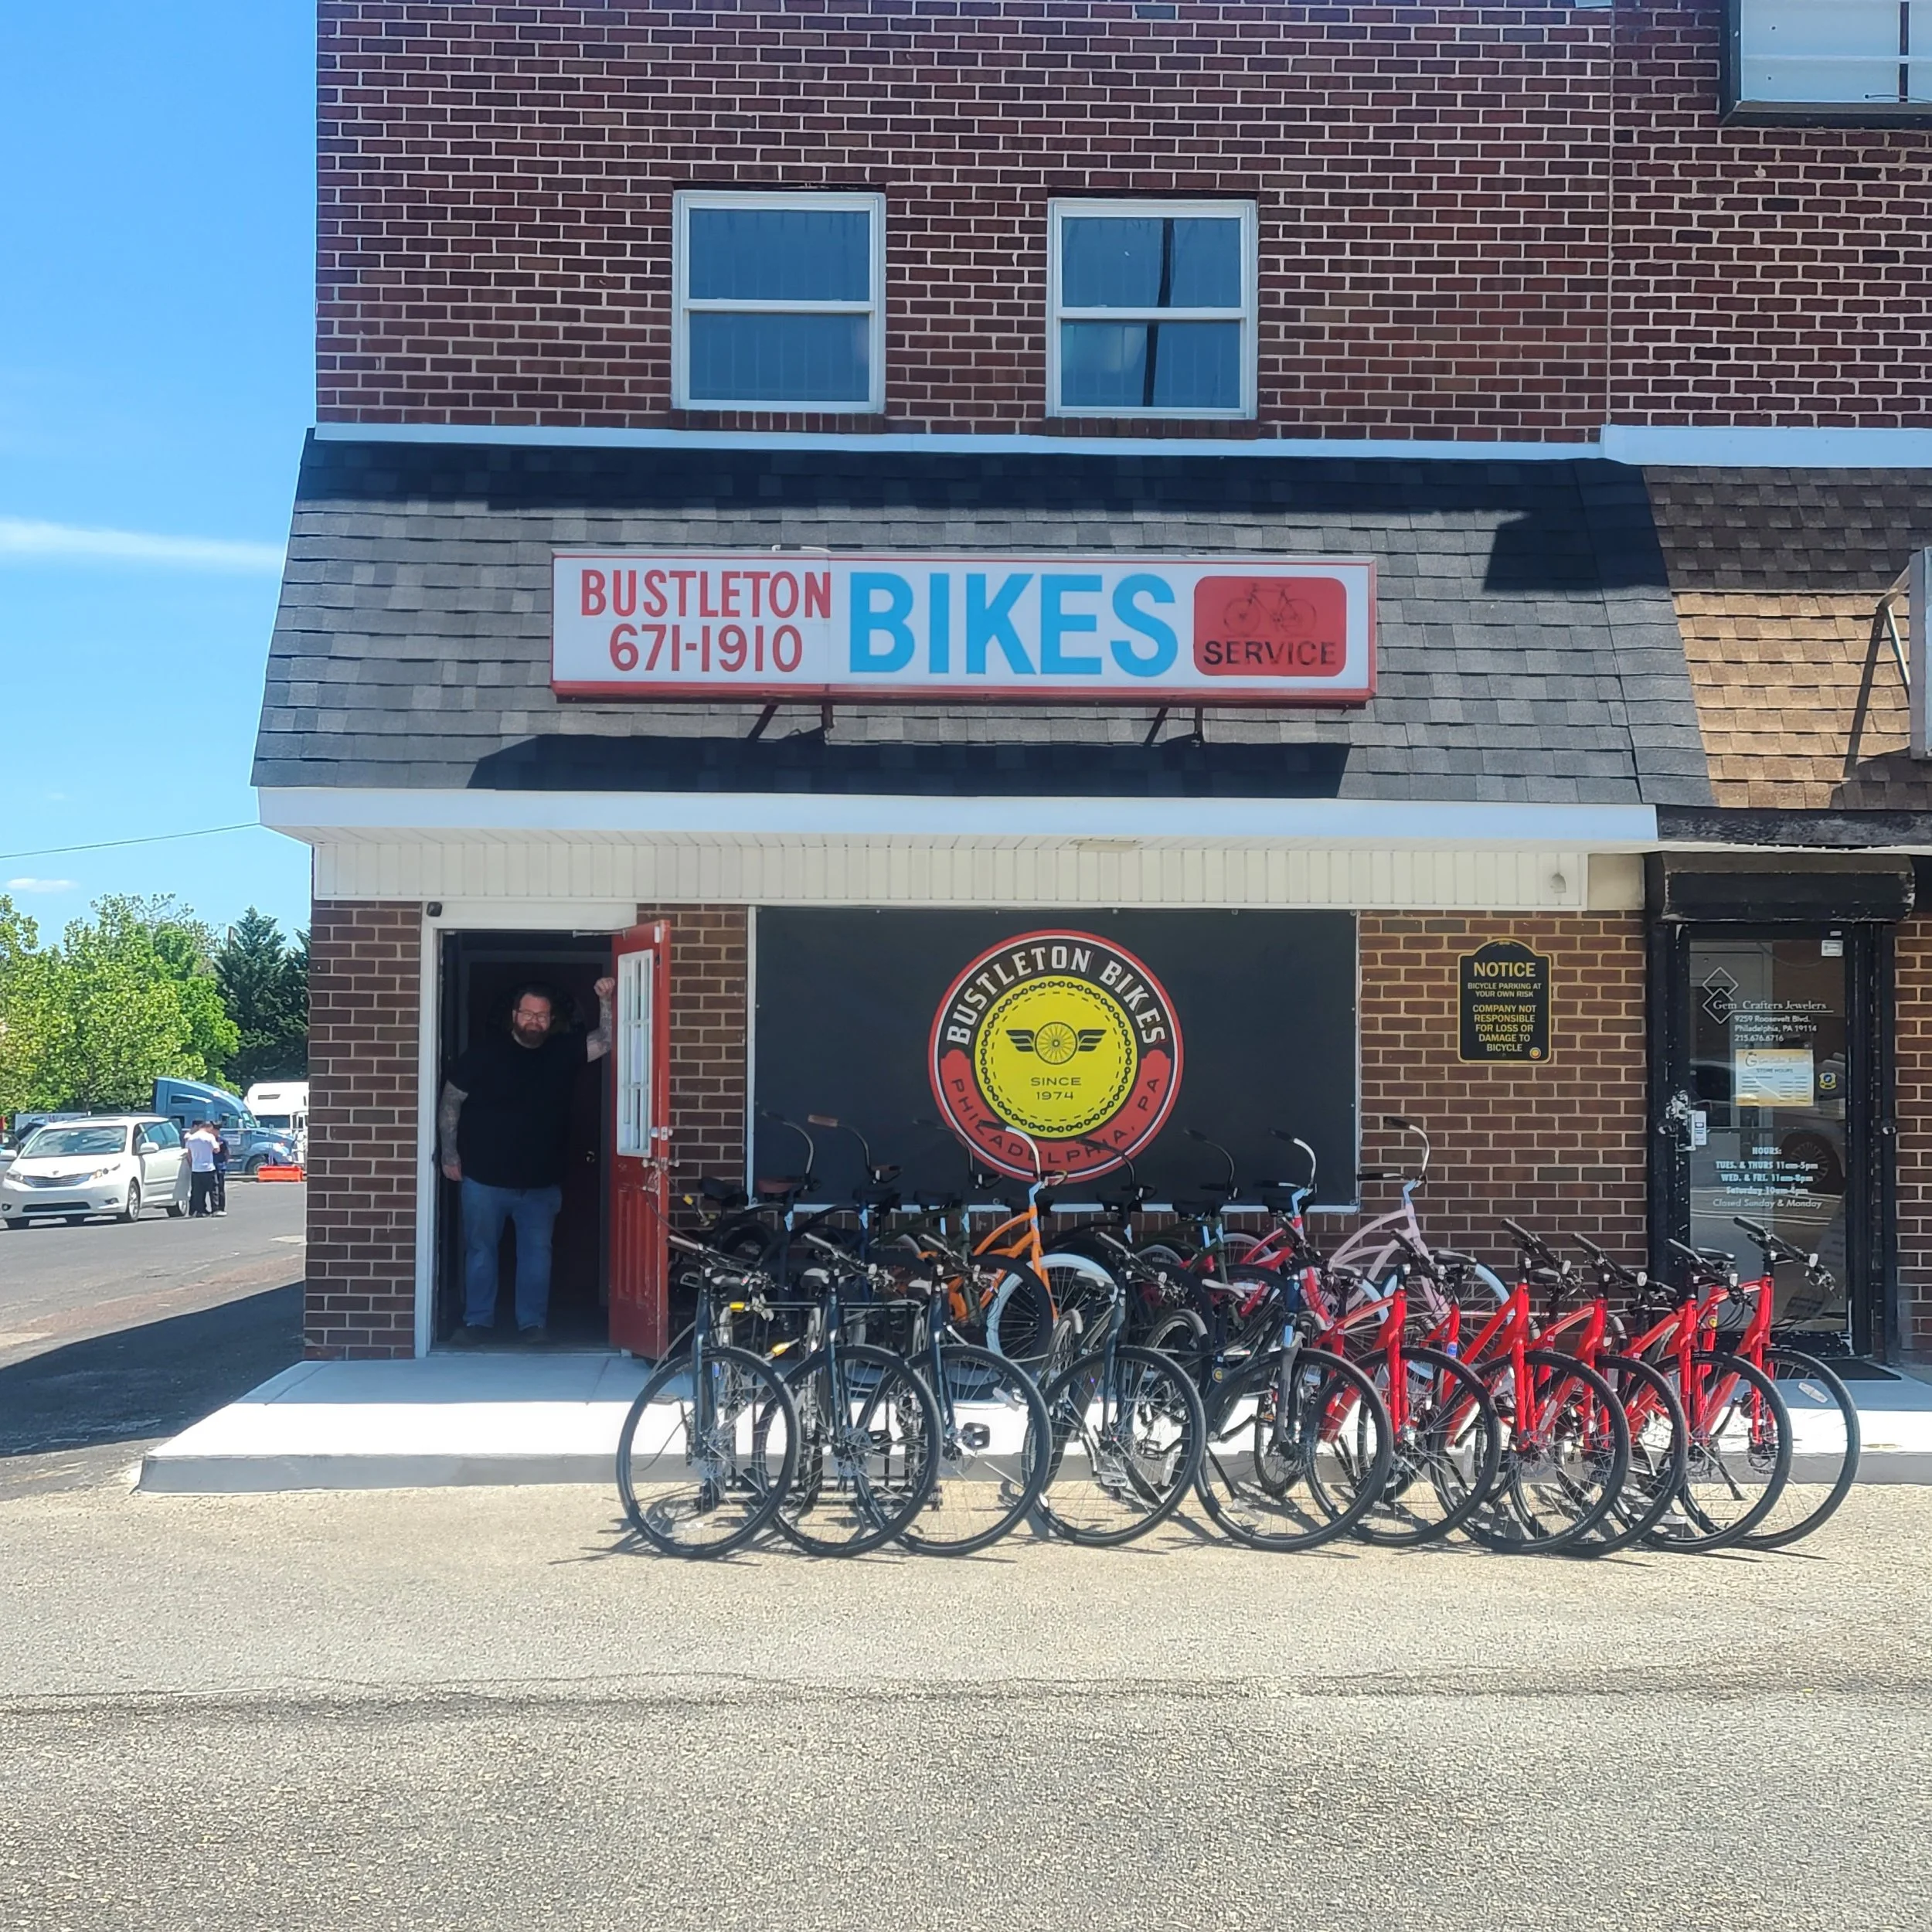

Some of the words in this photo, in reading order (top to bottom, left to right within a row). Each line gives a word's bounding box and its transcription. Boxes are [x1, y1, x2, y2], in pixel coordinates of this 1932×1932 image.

[581, 570, 831, 618] BUSTLETON
[849, 572, 1179, 677] BIKES
[609, 623, 802, 672] 671-1910
[1203, 641, 1336, 665] SERVICE
[1474, 962, 1536, 977] NOTICE
[947, 946, 1091, 1045] BUSTLETON
[1099, 961, 1165, 1044] BIKES
[1472, 1005, 1516, 1013] COMPANY
[1519, 1005, 1537, 1013] NOT
[1713, 1000, 1737, 1010] Gem
[1742, 1000, 1783, 1010] Crafters
[1784, 1000, 1827, 1010] Jewelers
[1734, 1025, 1781, 1034] Philadelphia,
[1478, 1034, 1516, 1043] DAMAGE
[1519, 1034, 1531, 1043] TO
[1030, 1077, 1082, 1087] SINCE
[1036, 1091, 1074, 1100] 1974
[1137, 1079, 1160, 1111] PA
[1720, 1173, 1742, 1182] WED.
[1743, 1173, 1750, 1182] &
[1726, 1185, 1763, 1196] Saturday
[1713, 1199, 1741, 1207] Closed
[1743, 1199, 1775, 1209] Sunday
[1786, 1199, 1822, 1209] Monday
